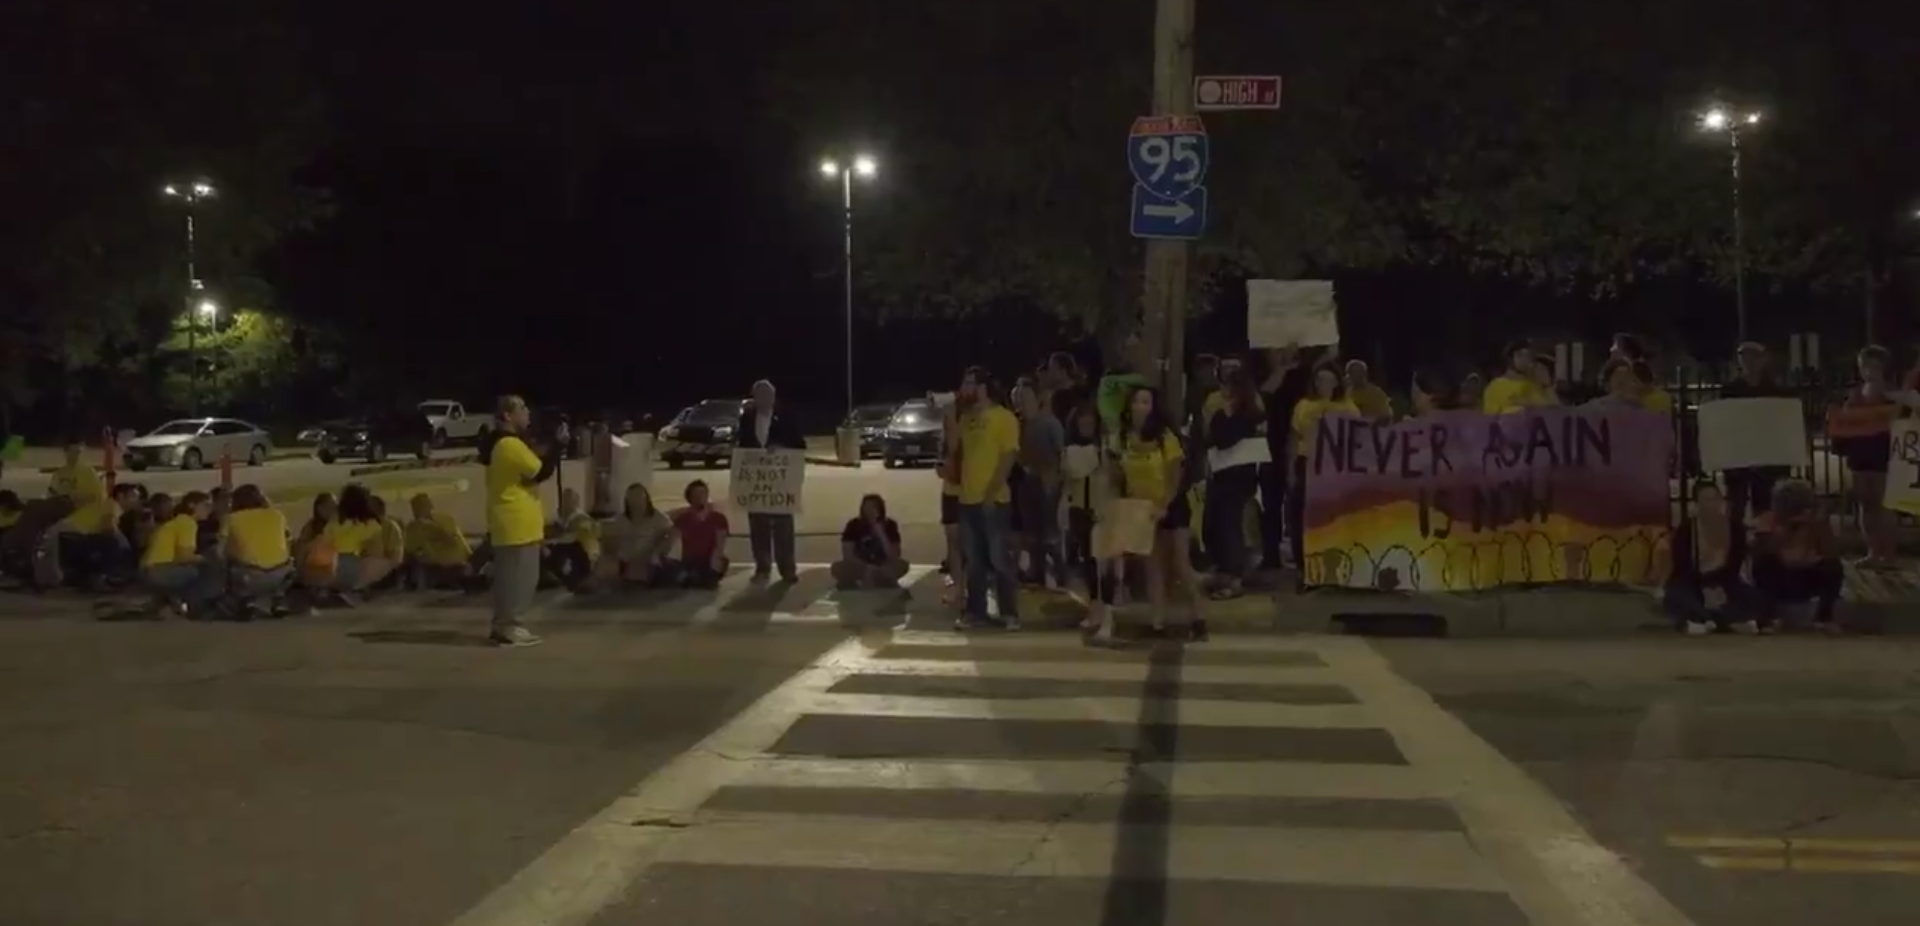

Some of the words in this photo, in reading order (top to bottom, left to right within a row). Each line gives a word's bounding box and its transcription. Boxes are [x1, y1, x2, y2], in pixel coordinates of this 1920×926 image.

[1223, 80, 1258, 104] HIGH
[1139, 136, 1201, 184] 95
[1314, 416, 1453, 479] NEVER
[1481, 415, 1613, 470] AGAIN
[756, 468, 787, 482] NOT
[736, 492, 795, 507] OPTION
[753, 483, 773, 492] AN
[1418, 486, 1452, 540] IS
[1471, 477, 1551, 534] NOW
